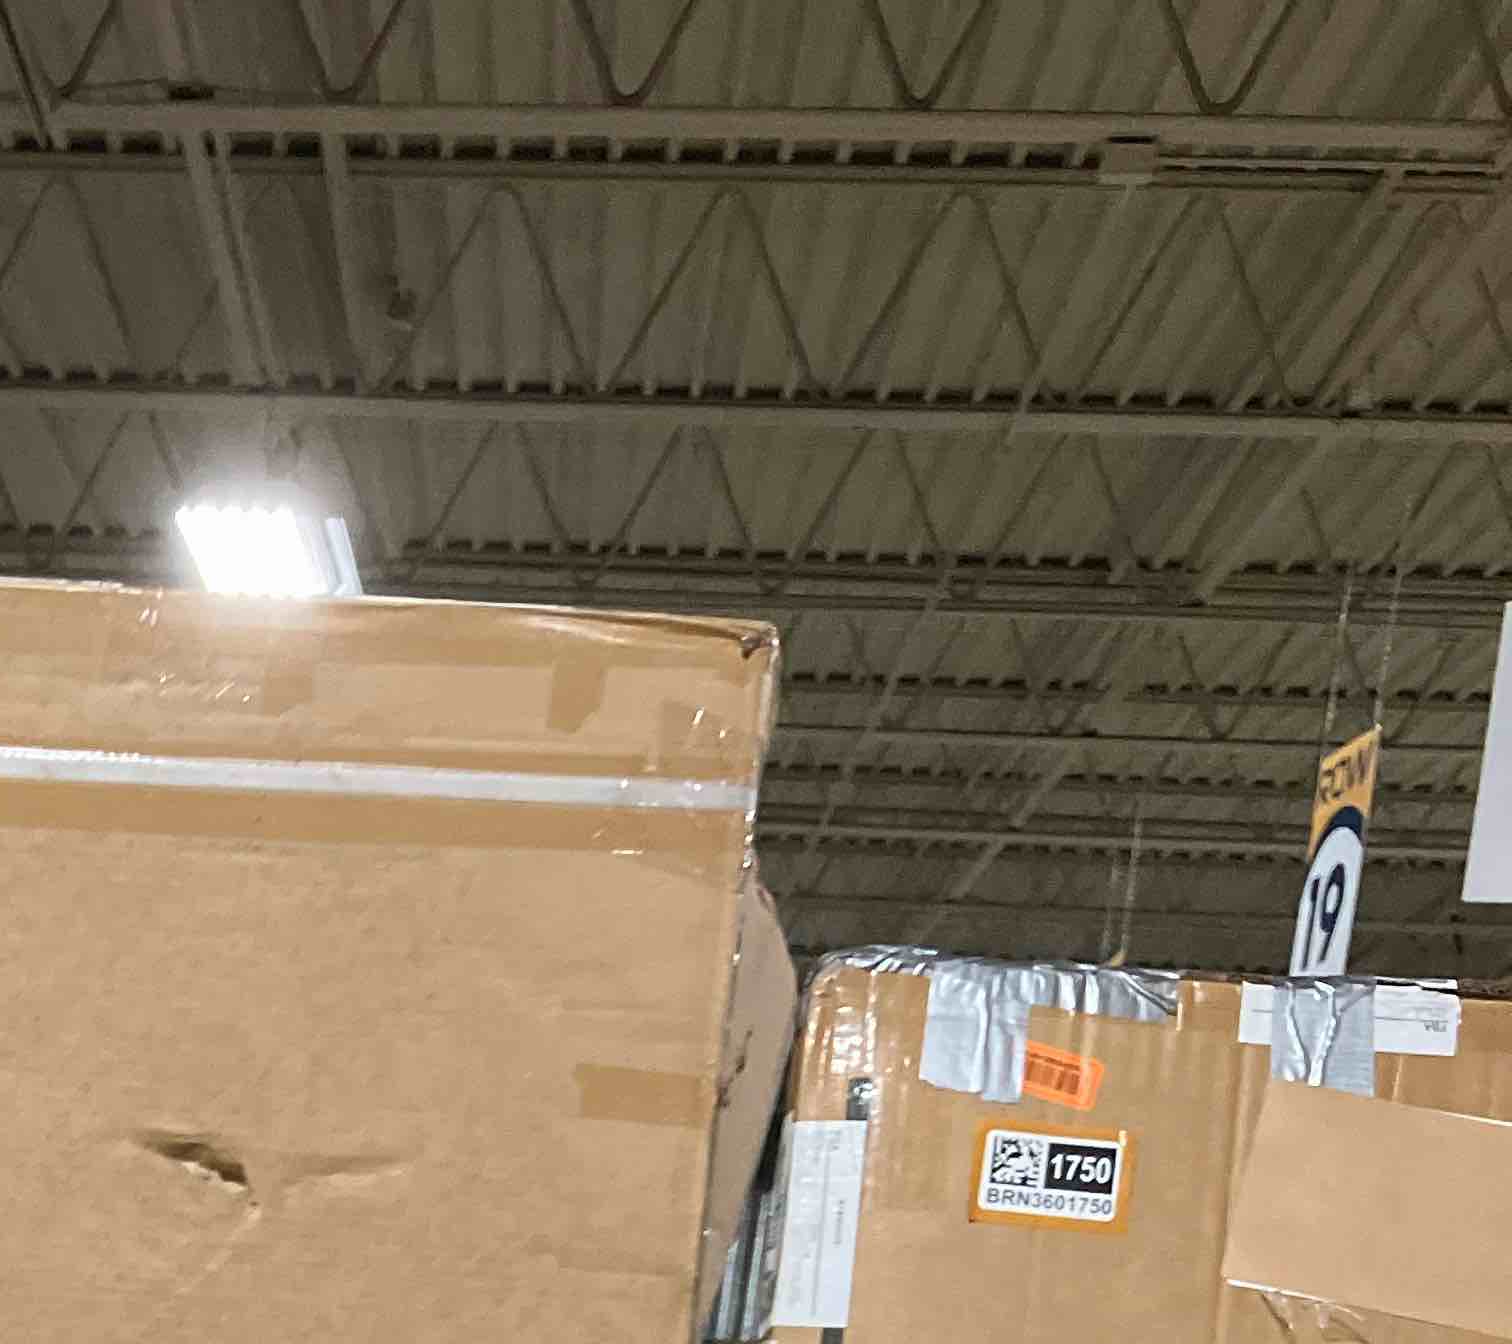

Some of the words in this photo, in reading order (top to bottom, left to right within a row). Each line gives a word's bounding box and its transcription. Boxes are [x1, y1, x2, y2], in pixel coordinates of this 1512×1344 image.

[1301, 862, 1346, 972] 19
[1049, 1152, 1113, 1185] 1750
[986, 1186, 1114, 1216] BRN3601750
